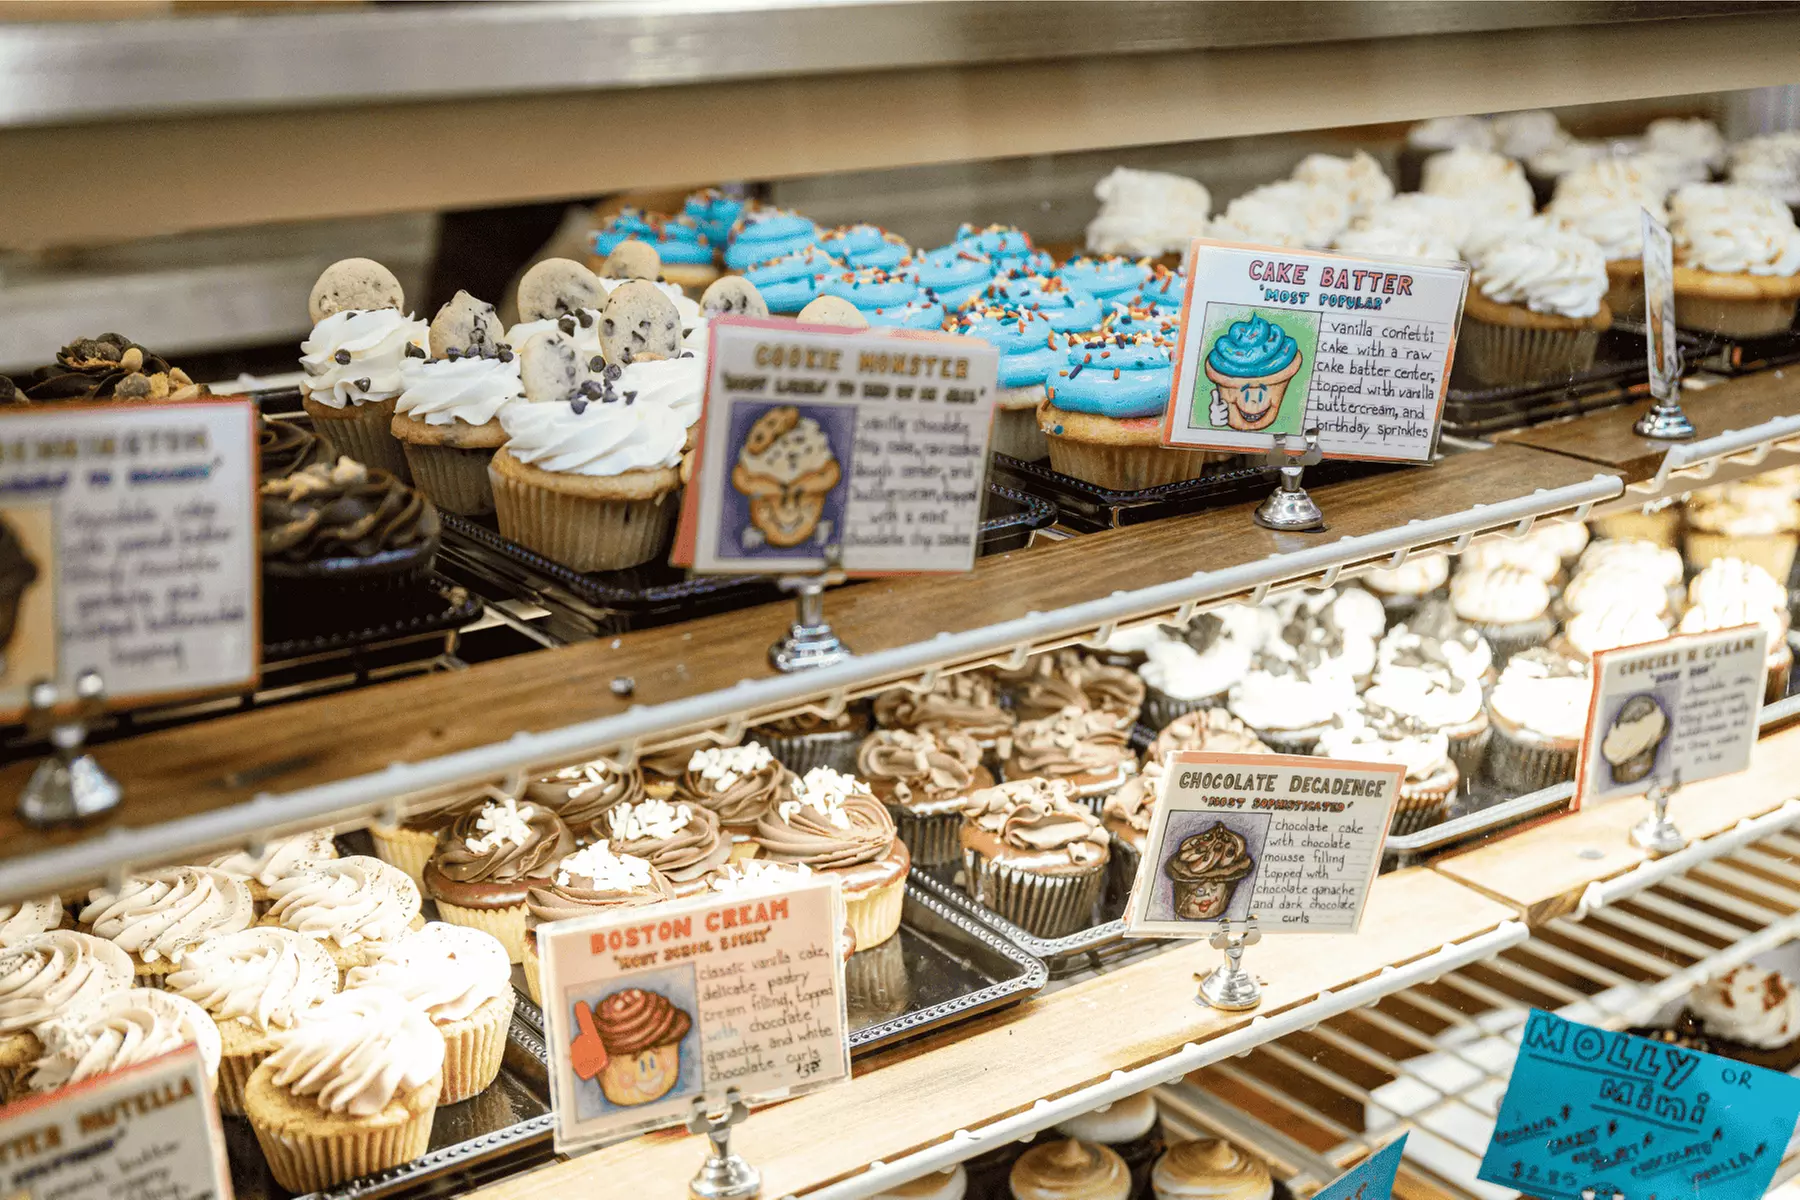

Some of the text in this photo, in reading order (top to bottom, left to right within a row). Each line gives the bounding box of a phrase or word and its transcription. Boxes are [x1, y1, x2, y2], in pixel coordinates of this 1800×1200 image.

[1249, 260, 1413, 296] CAKE BATTER
[1331, 319, 1435, 343] vanilla confetti
[755, 343, 970, 380] COOKIE MONSTER
[1358, 339, 1385, 358] with
[1391, 347, 1398, 358] a
[1406, 349, 1432, 360] raw
[1350, 359, 1391, 377] batter
[1394, 364, 1436, 384] center,
[1317, 374, 1434, 399] topped with vanilla
[1317, 395, 1425, 420] buttercream, and
[1317, 415, 1428, 441] birthday sprinkles
[1179, 771, 1386, 798] CHOCOLATE DECADENCE
[1275, 817, 1364, 834] chocolate cake
[1269, 832, 1351, 849] with chocolate
[1264, 849, 1346, 872] mousse filling
[1264, 863, 1329, 883] topped with
[1253, 895, 1355, 909] and dark chocolate
[1256, 880, 1355, 901] chocolate ganache
[590, 897, 790, 955] BOSTON CREAM
[1282, 911, 1310, 923] curls
[699, 963, 745, 981] classic
[752, 949, 791, 969] vanilla
[702, 967, 810, 1001] delicate pastry
[703, 1005, 746, 1022] cream
[796, 978, 834, 1009] topped
[708, 1006, 812, 1042] with chocolate
[707, 1019, 834, 1070] ganache and white
[1526, 1015, 1753, 1090] MOLLY OR
[709, 1045, 821, 1082] chocolate curls
